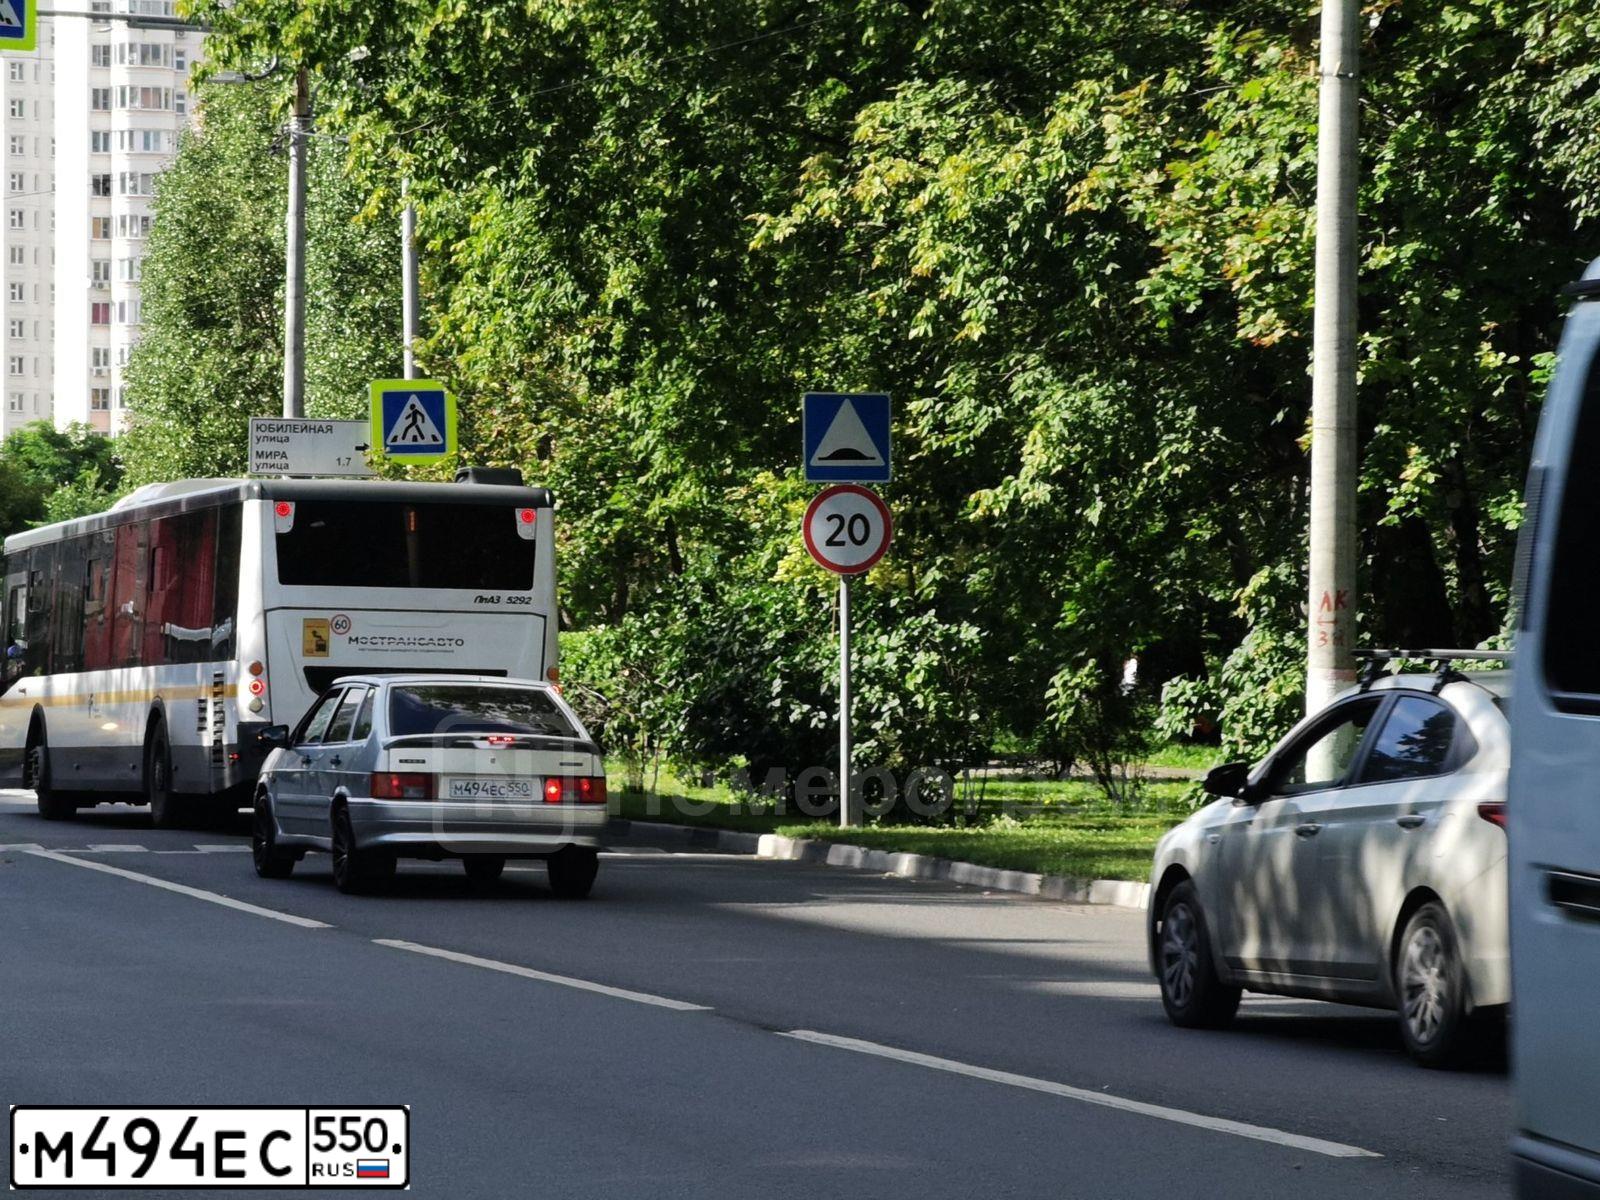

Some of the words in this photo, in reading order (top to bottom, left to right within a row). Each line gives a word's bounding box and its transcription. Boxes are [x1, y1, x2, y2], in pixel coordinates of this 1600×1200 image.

[256, 423, 333, 433] ЮБИЛЕЙНАЯ
[255, 435, 290, 444] улица
[255, 450, 288, 460] МИРА
[255, 462, 289, 471] улица
[825, 513, 871, 547] 20
[506, 595, 532, 605] 5292
[335, 619, 348, 630] 60
[348, 636, 465, 647] МОСТРАНСАВТО
[507, 782, 529, 793] 550
